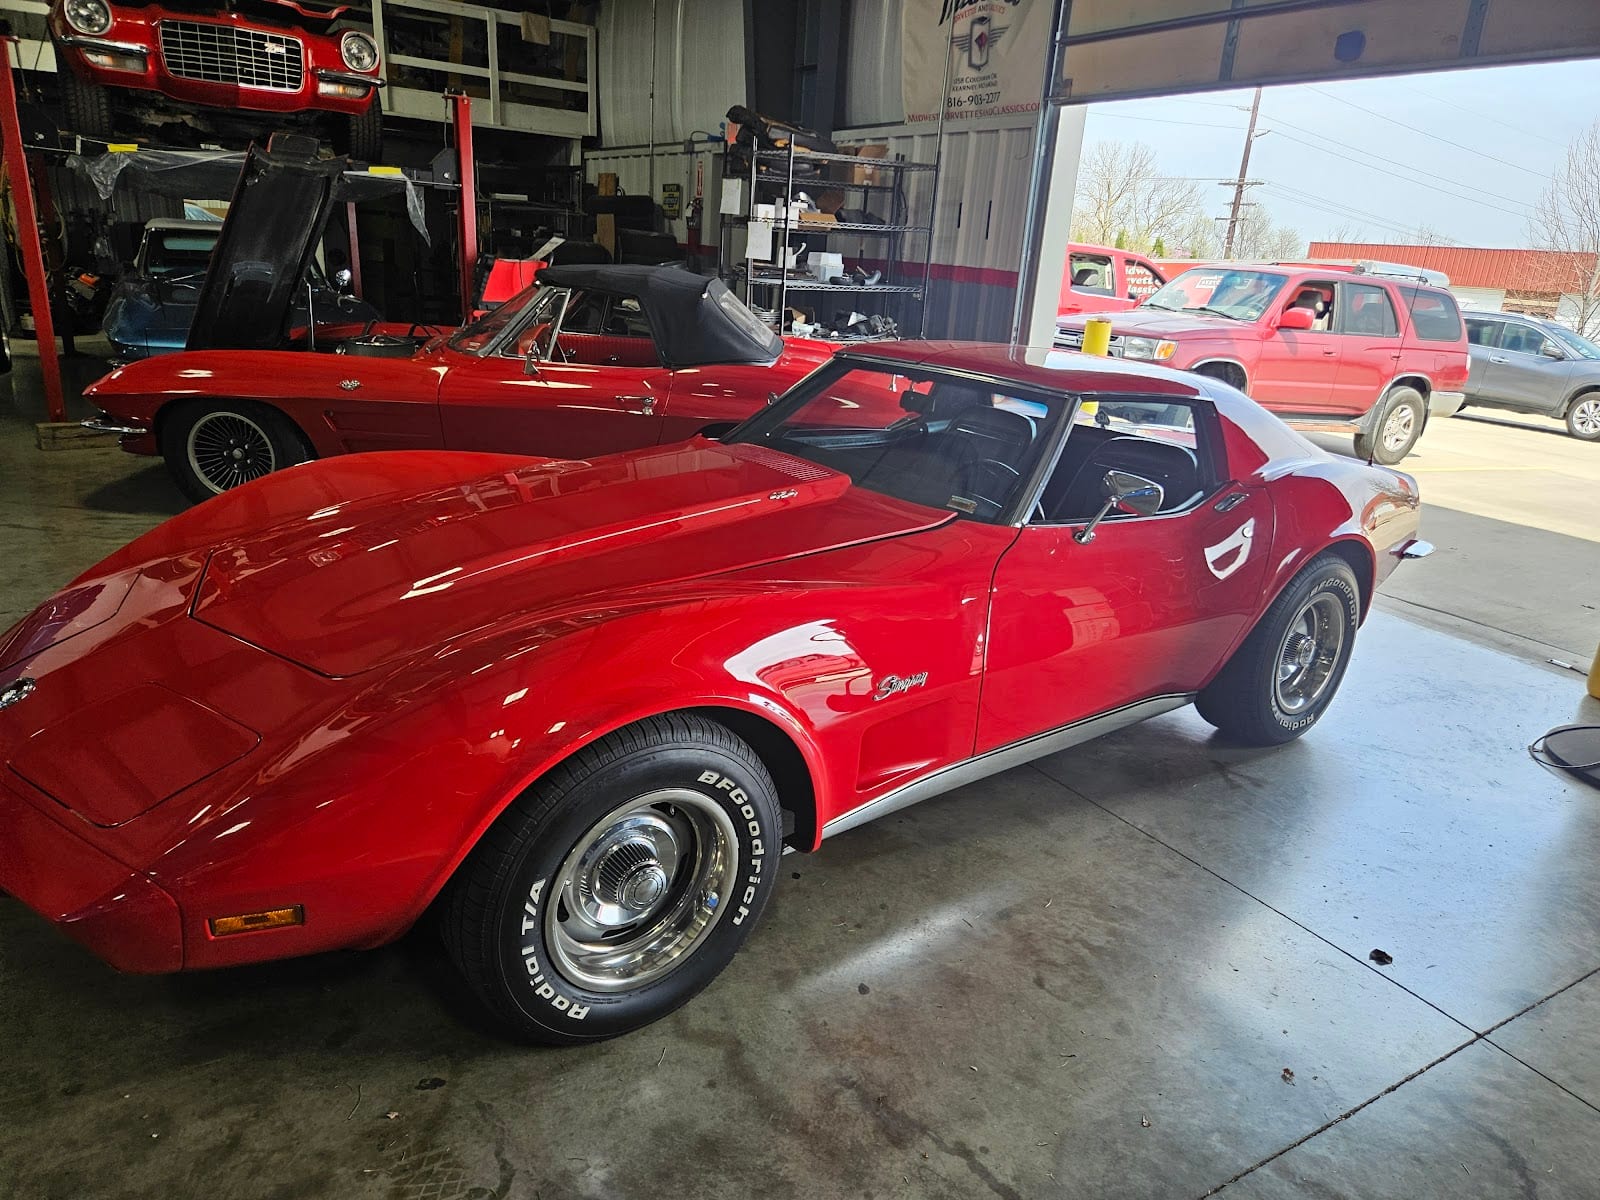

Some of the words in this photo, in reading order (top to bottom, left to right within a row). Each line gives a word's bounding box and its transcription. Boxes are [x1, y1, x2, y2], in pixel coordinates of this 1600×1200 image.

[1279, 712, 1315, 731] Radial
[697, 770, 765, 927] BFGoodrich
[521, 877, 547, 937] T/A
[521, 945, 592, 1021] Radial
